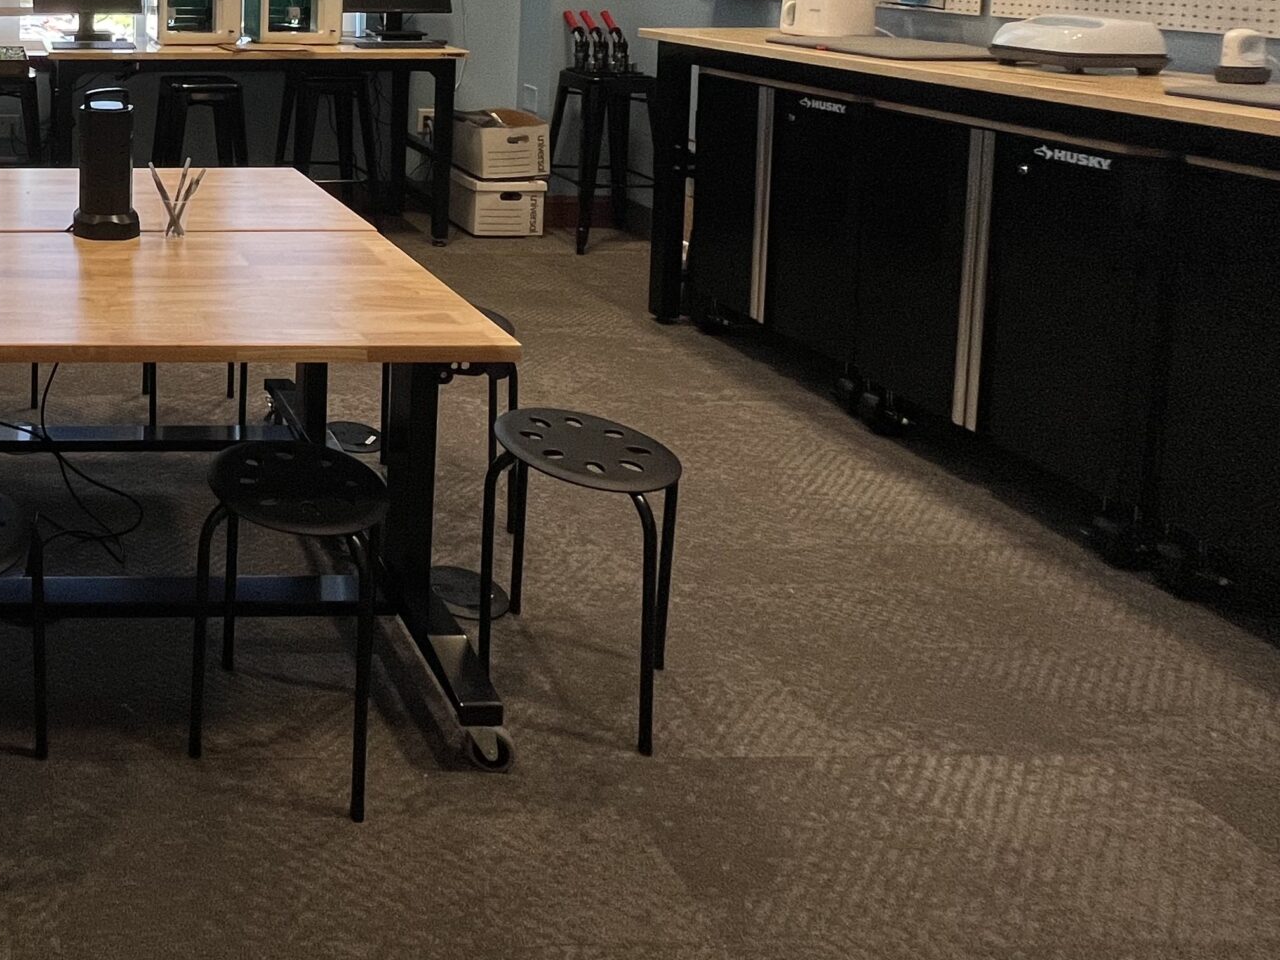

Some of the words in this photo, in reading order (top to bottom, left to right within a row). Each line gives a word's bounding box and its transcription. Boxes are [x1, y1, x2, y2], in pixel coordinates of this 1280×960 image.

[811, 99, 847, 114] HUSKY
[537, 135, 547, 173] universal
[1053, 148, 1112, 170] HUSKY
[529, 195, 539, 234] universal
